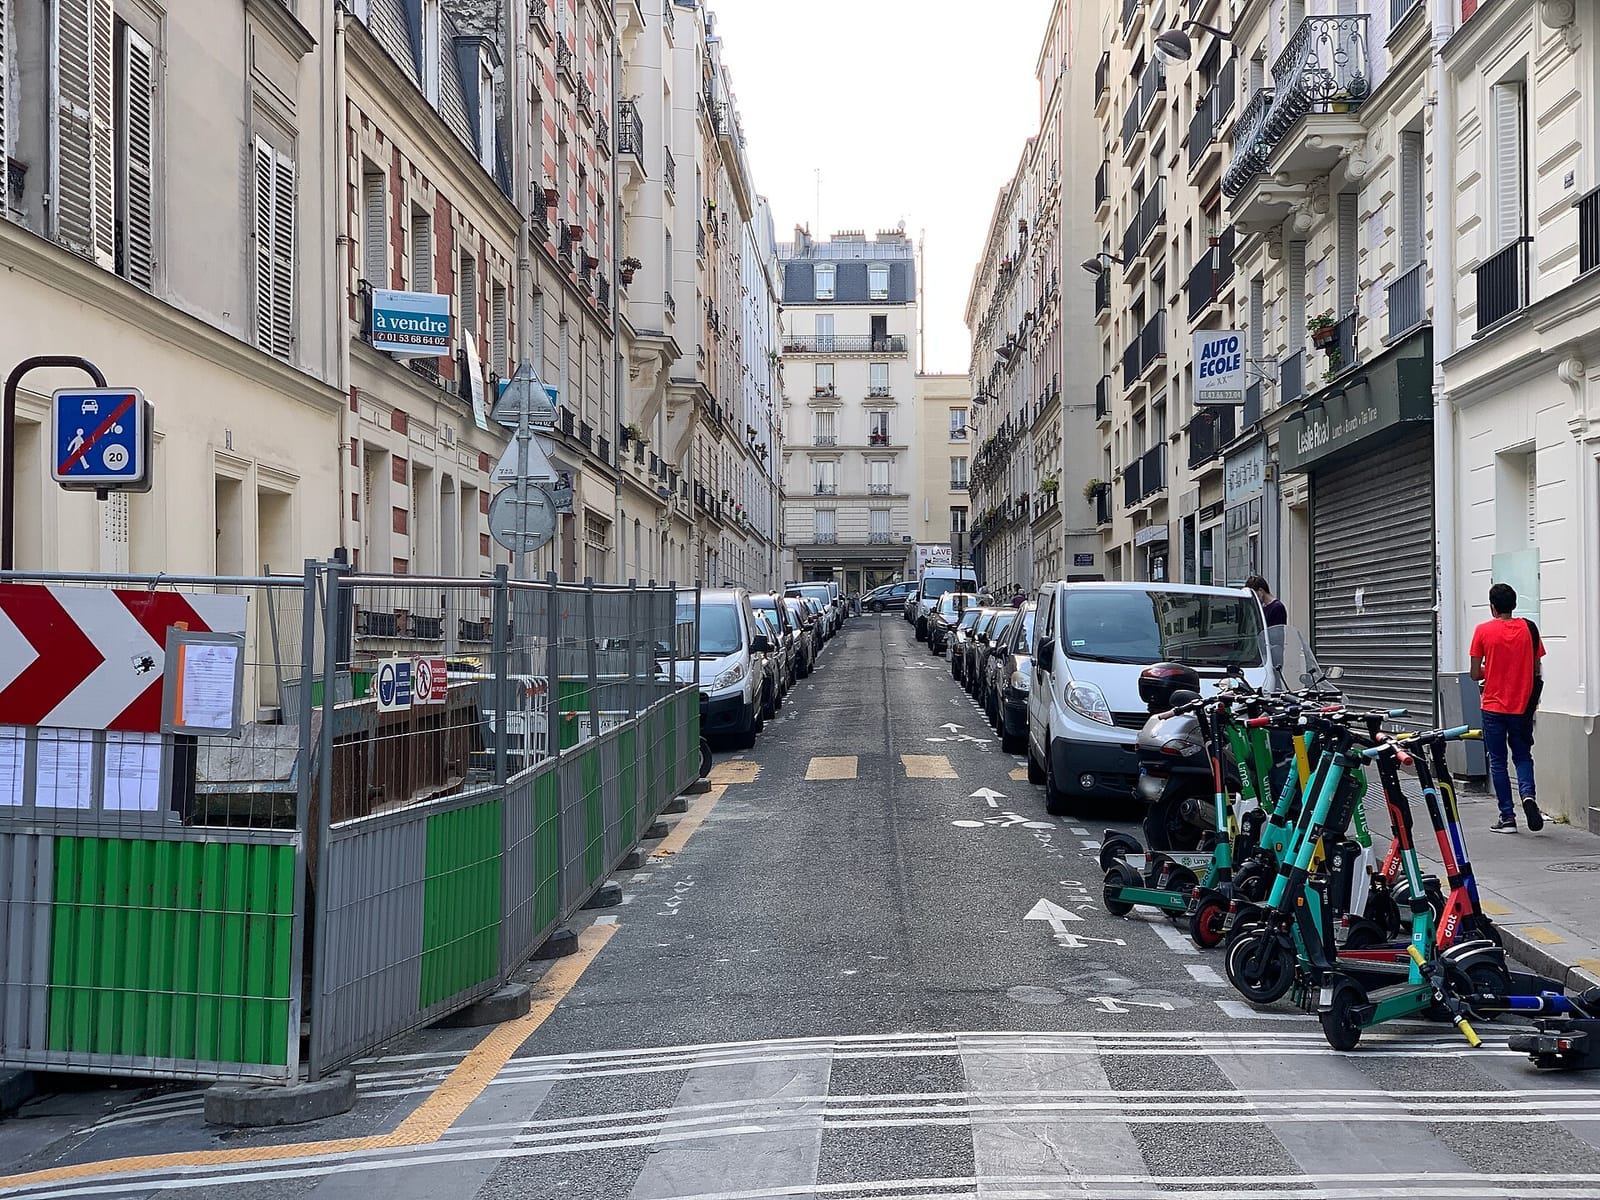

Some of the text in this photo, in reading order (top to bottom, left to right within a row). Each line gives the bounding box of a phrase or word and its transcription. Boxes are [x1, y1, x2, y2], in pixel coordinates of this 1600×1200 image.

[376, 312, 447, 333] à vendre
[387, 333, 445, 345] 01 53 68 64 02
[1201, 336, 1239, 360] AUTO
[1200, 353, 1241, 379] ECOLE
[108, 452, 123, 462] 20
[931, 548, 951, 556] LAVE
[1237, 761, 1250, 787] Lime
[1276, 776, 1294, 810] TIER
[1202, 865, 1213, 887] dott
[1389, 856, 1400, 876] dott
[1445, 913, 1458, 938] dott
